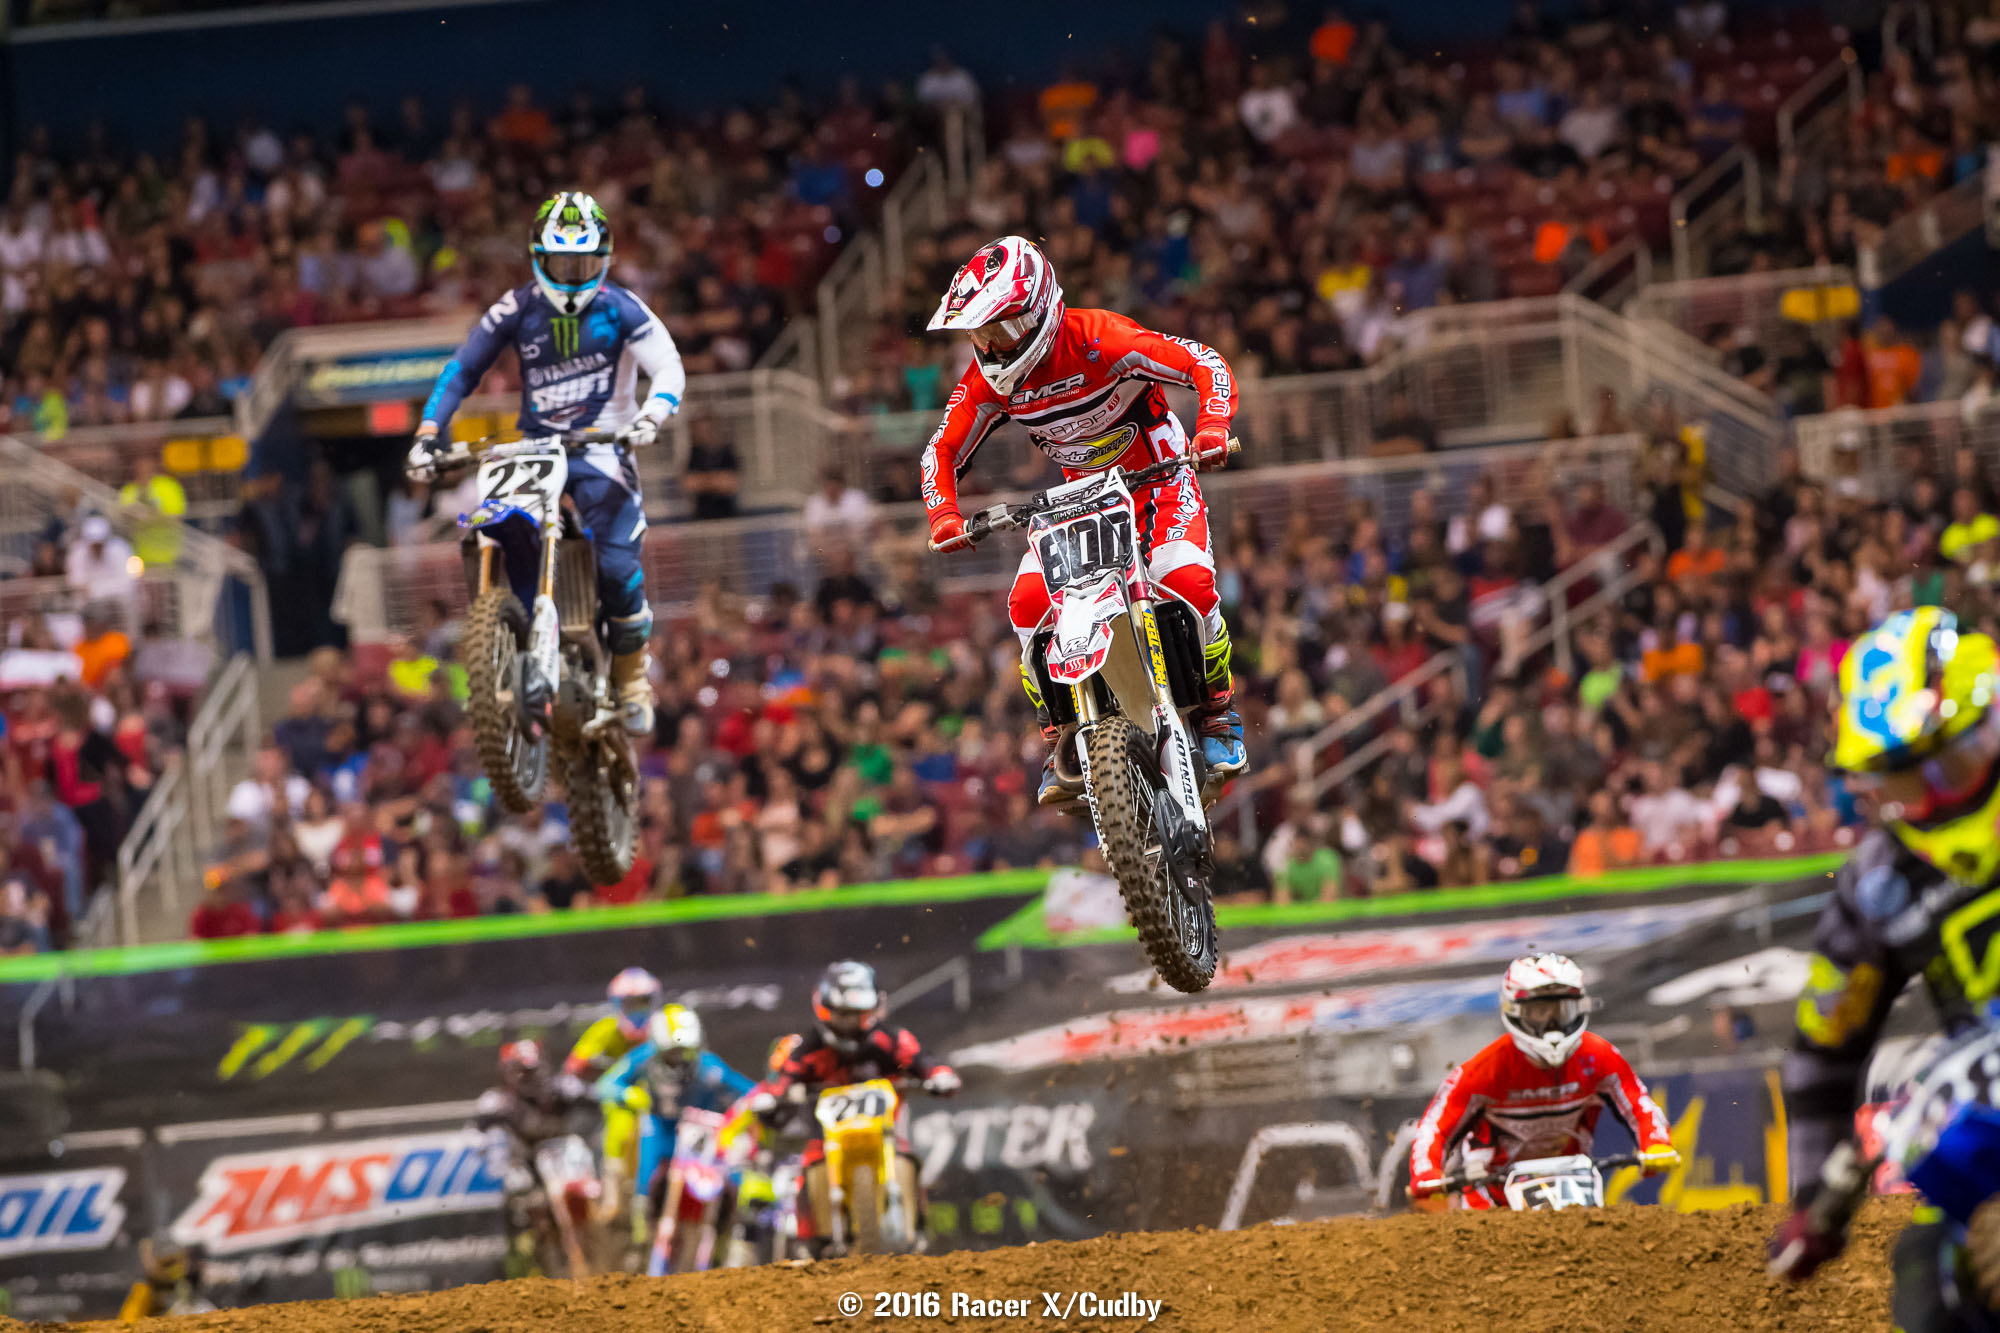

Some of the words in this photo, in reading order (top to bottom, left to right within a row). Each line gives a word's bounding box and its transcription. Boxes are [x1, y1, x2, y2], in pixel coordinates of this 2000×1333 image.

[486, 460, 554, 500] 22
[1173, 729, 1197, 809] DUNLOP
[196, 1146, 504, 1238] AMSOIL
